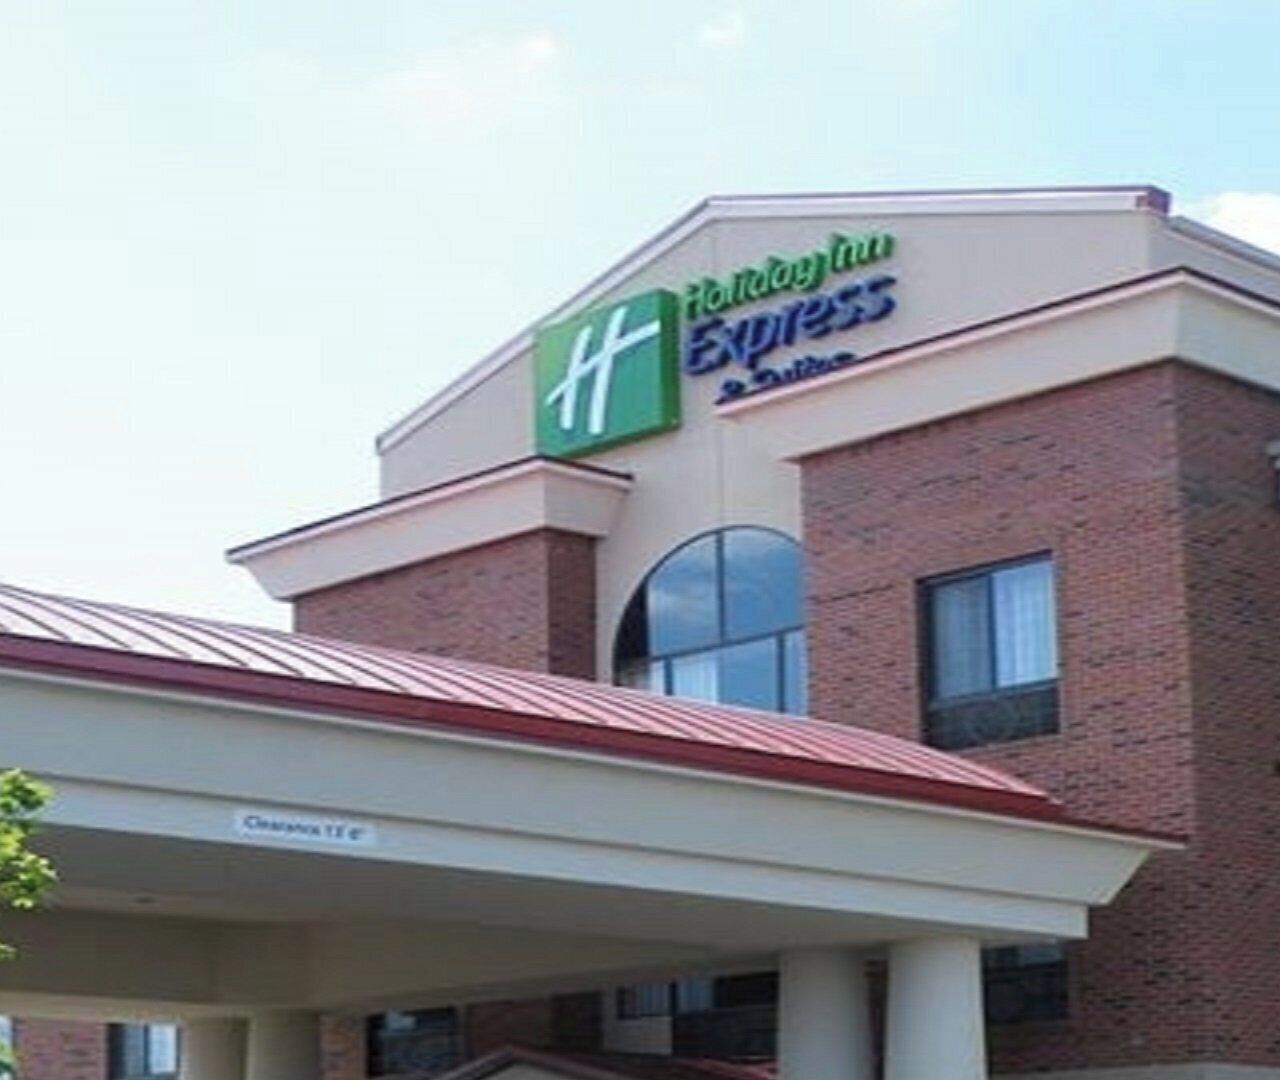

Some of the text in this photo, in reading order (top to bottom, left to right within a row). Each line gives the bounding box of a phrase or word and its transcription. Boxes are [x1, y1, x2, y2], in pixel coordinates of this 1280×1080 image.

[683, 231, 896, 318] Holiday Inn
[684, 274, 897, 375] Express
[243, 815, 321, 836] Clearance
